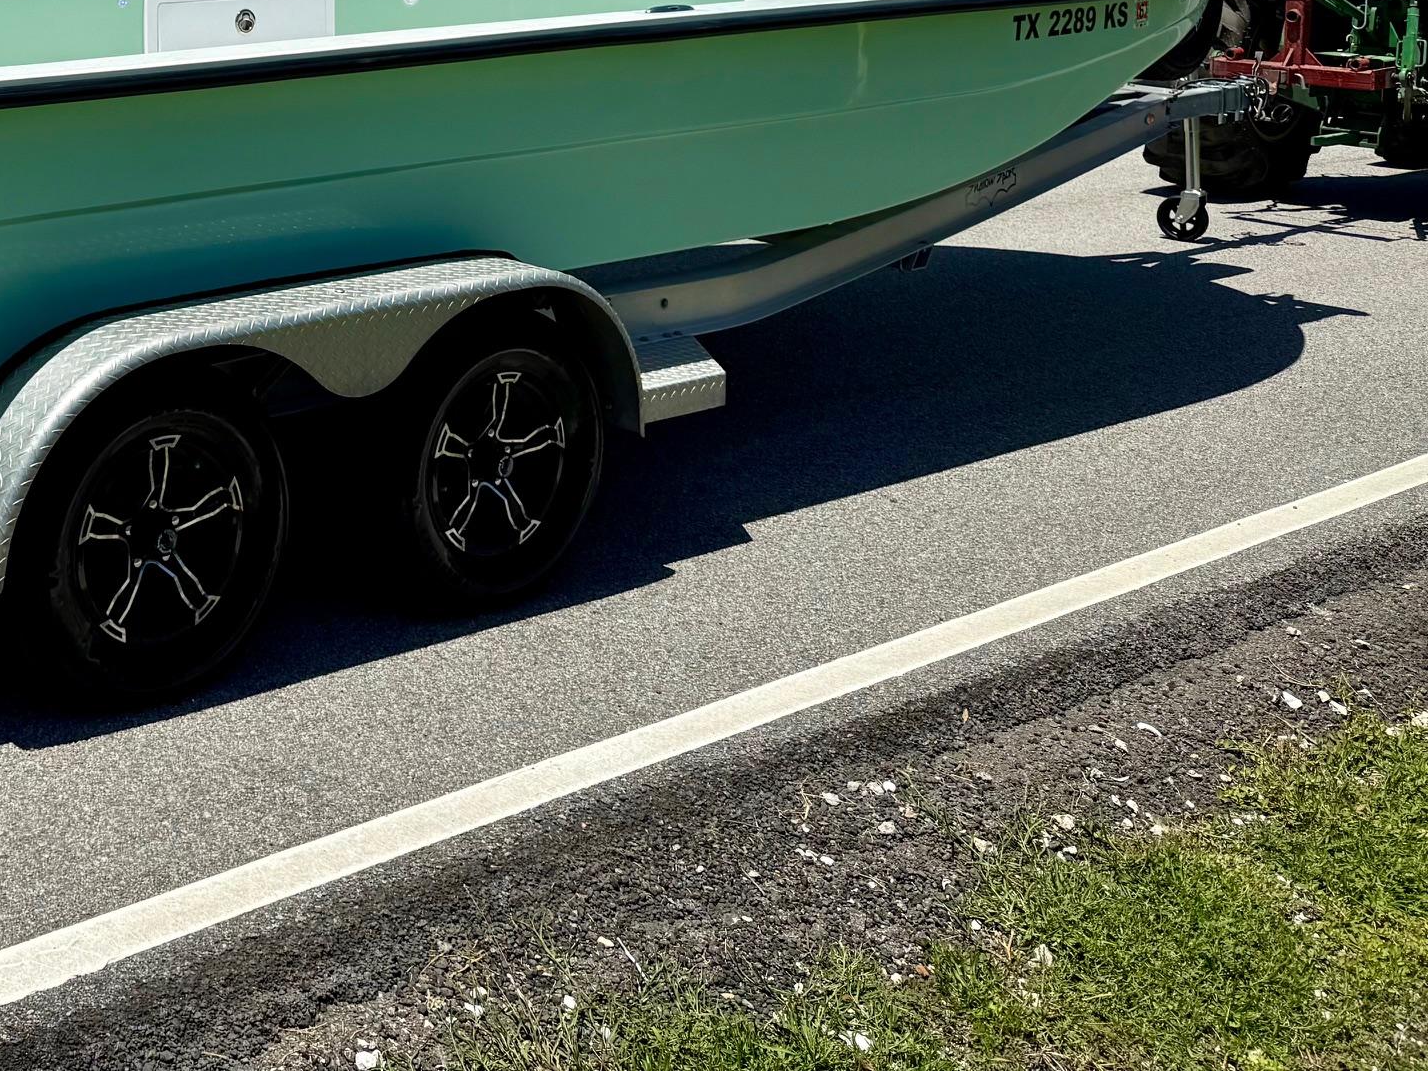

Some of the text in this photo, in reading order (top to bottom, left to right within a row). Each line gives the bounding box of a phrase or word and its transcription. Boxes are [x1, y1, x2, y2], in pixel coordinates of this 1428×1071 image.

[1013, 12, 1040, 41] TX
[1048, 6, 1096, 37] 2289
[1104, 1, 1128, 30] KS
